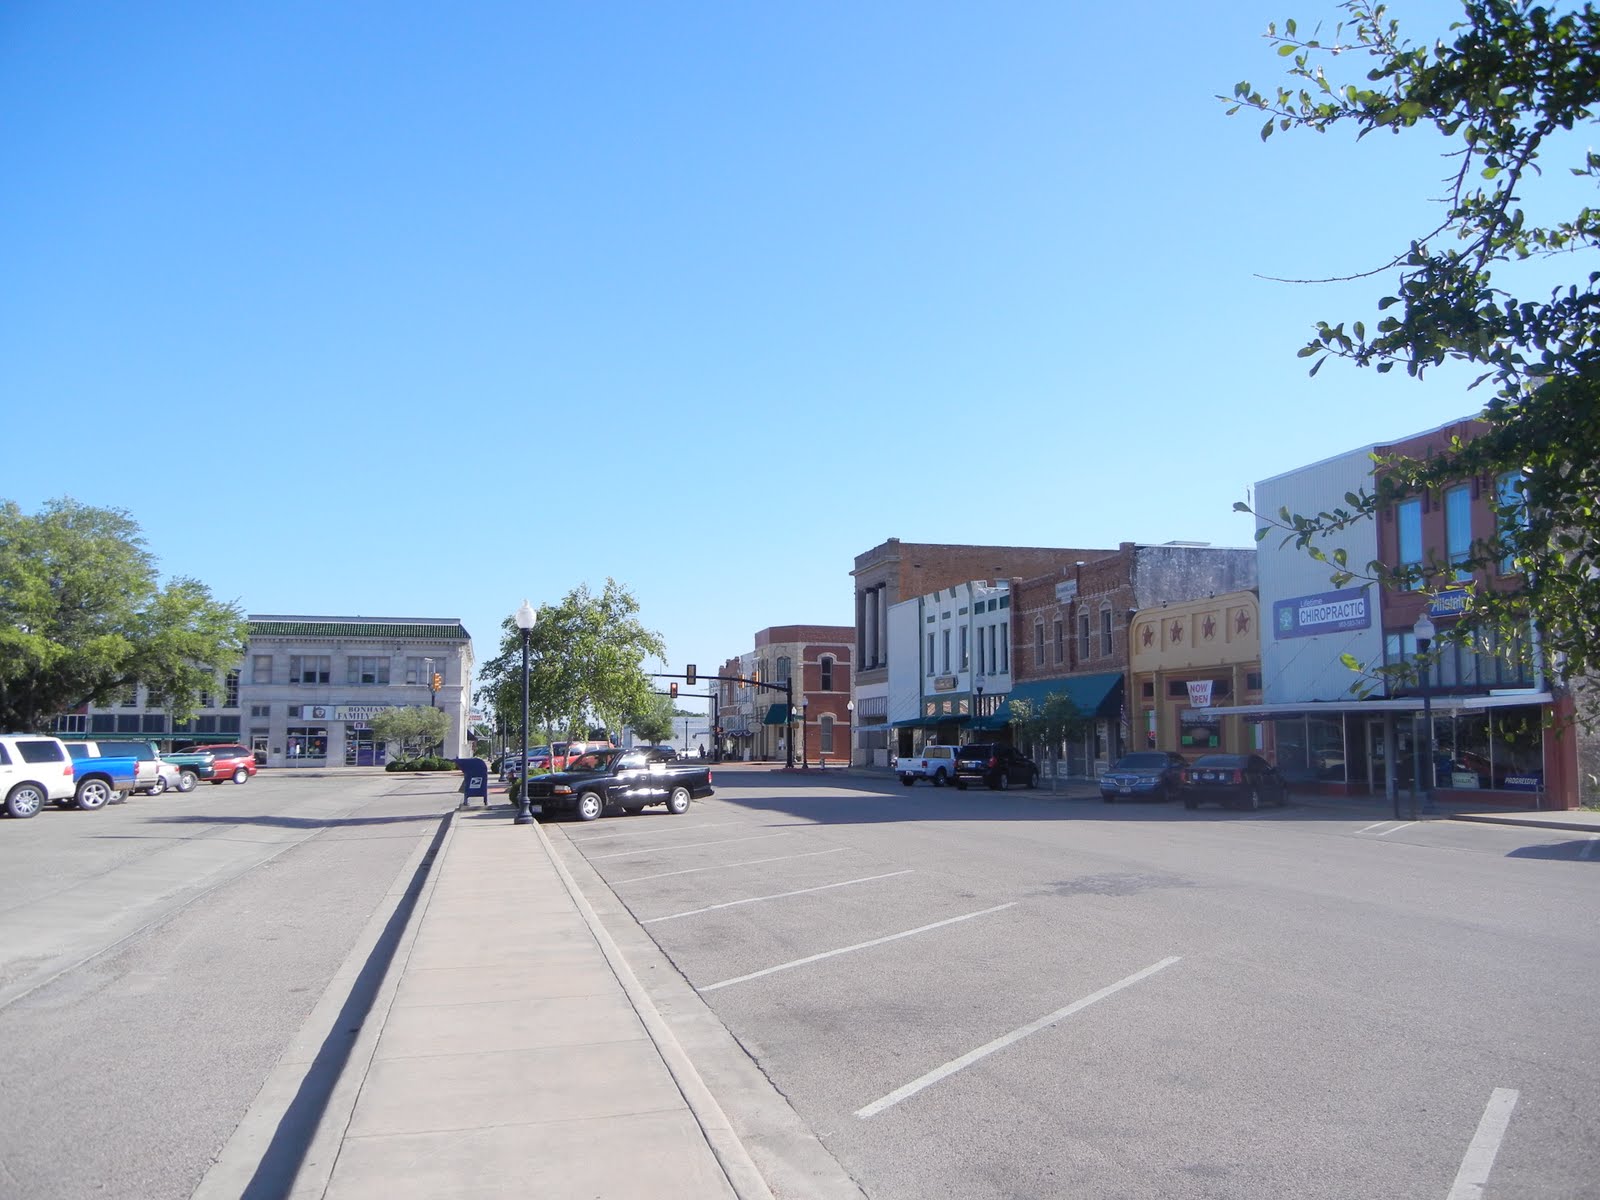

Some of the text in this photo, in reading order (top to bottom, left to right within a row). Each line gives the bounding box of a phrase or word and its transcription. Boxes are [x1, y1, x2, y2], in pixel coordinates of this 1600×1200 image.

[1300, 599, 1322, 608] Lifetime
[1300, 602, 1364, 623] CHIROPRACTIC
[1190, 683, 1208, 693] NOW
[1504, 777, 1538, 785] PROGRESSIVE
